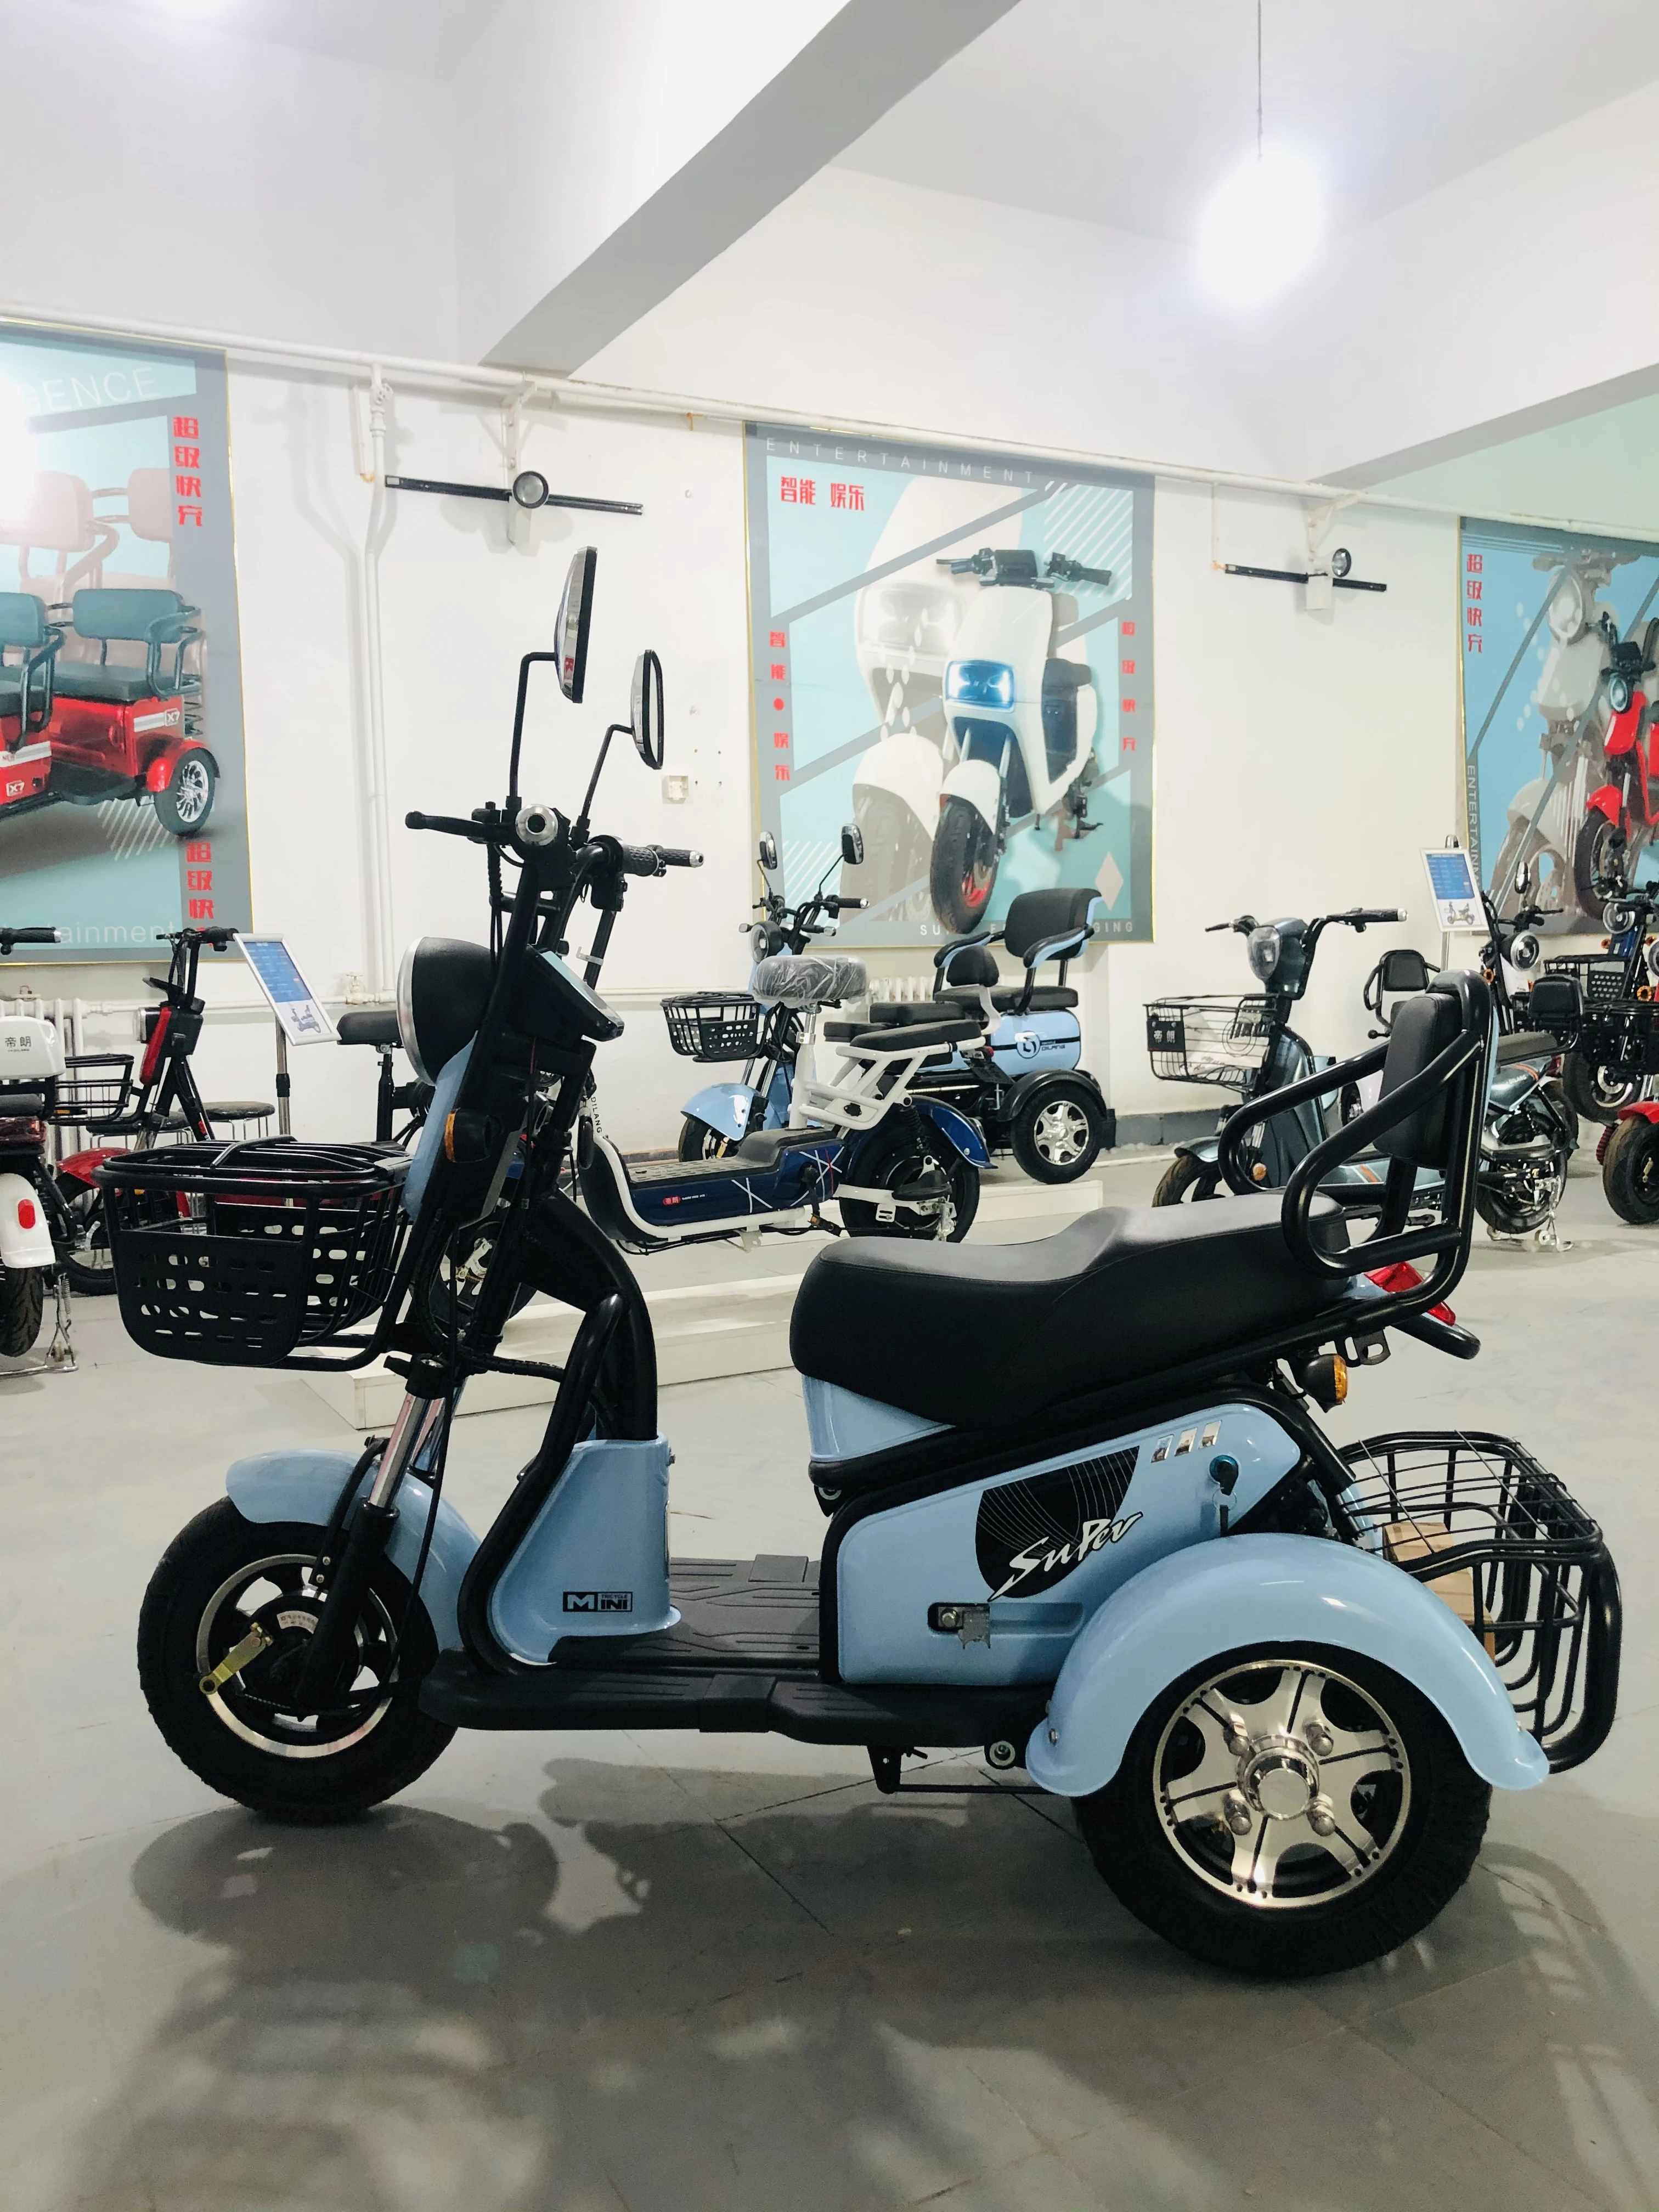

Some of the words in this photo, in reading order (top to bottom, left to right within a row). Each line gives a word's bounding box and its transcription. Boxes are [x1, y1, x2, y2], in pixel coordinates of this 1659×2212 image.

[766, 437, 1034, 483] ENTERTAINMENT
[780, 476, 816, 505] 智能
[830, 482, 865, 511] 娱乐
[166, 709, 180, 723] X7
[9, 781, 25, 793] X7
[186, 842, 215, 931] 超级快
[4, 1036, 32, 1047] 帝朗
[591, 1097, 603, 1133] DILANG
